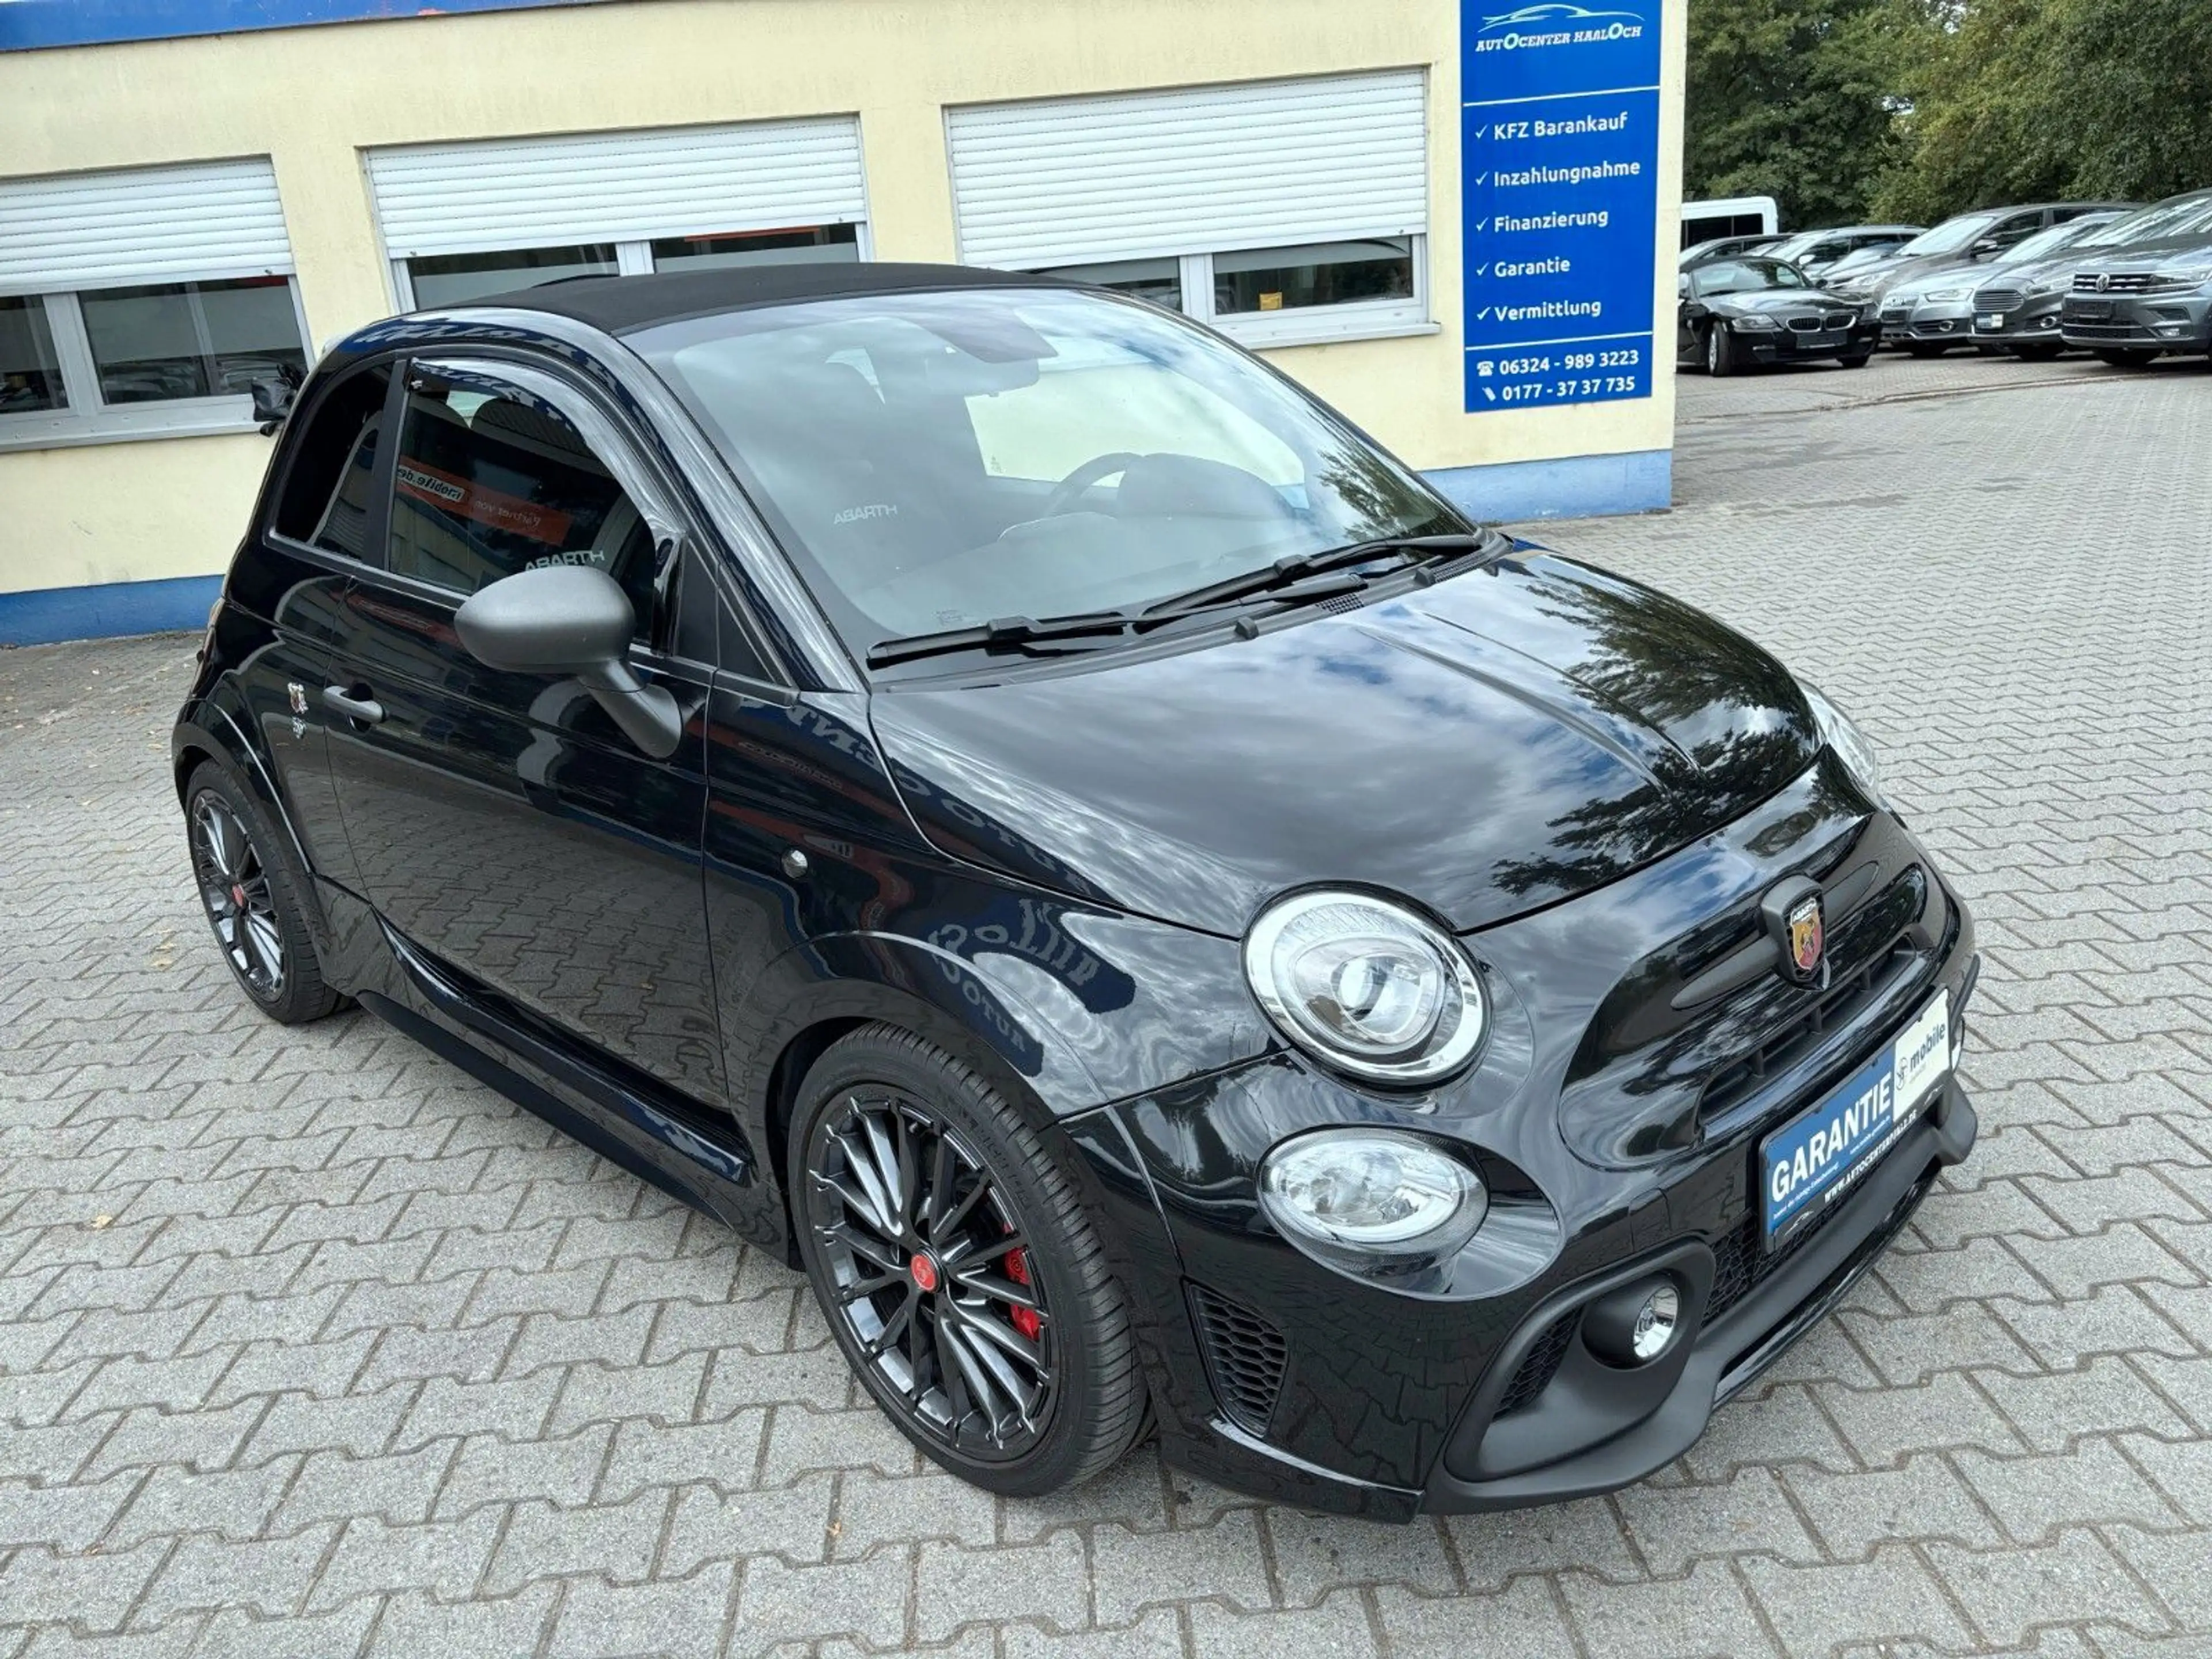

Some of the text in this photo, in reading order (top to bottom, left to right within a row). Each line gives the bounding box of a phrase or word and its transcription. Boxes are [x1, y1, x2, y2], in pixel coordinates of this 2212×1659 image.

[1475, 33, 1571, 52] AUTOCENTER
[1494, 112, 1628, 141] KFZ Barankauf
[1494, 161, 1641, 187] Inzahlungnahme
[1494, 210, 1608, 233] Finanzierung
[1494, 256, 1571, 277] Garantie
[1495, 300, 1602, 321] Vermittlung
[1499, 357, 1550, 375] 06324
[1565, 353, 1594, 370] 989
[1599, 350, 1639, 367] 3223
[1502, 384, 1543, 401] 0177
[1556, 381, 1577, 397] 37
[1581, 379, 1602, 395] 37
[1606, 376, 1636, 392] 735
[833, 505, 899, 525] ABARTH
[525, 550, 605, 571] ABARTH
[1910, 1023, 1946, 1072] mobile
[1772, 1070, 1892, 1203] GARANTIE
